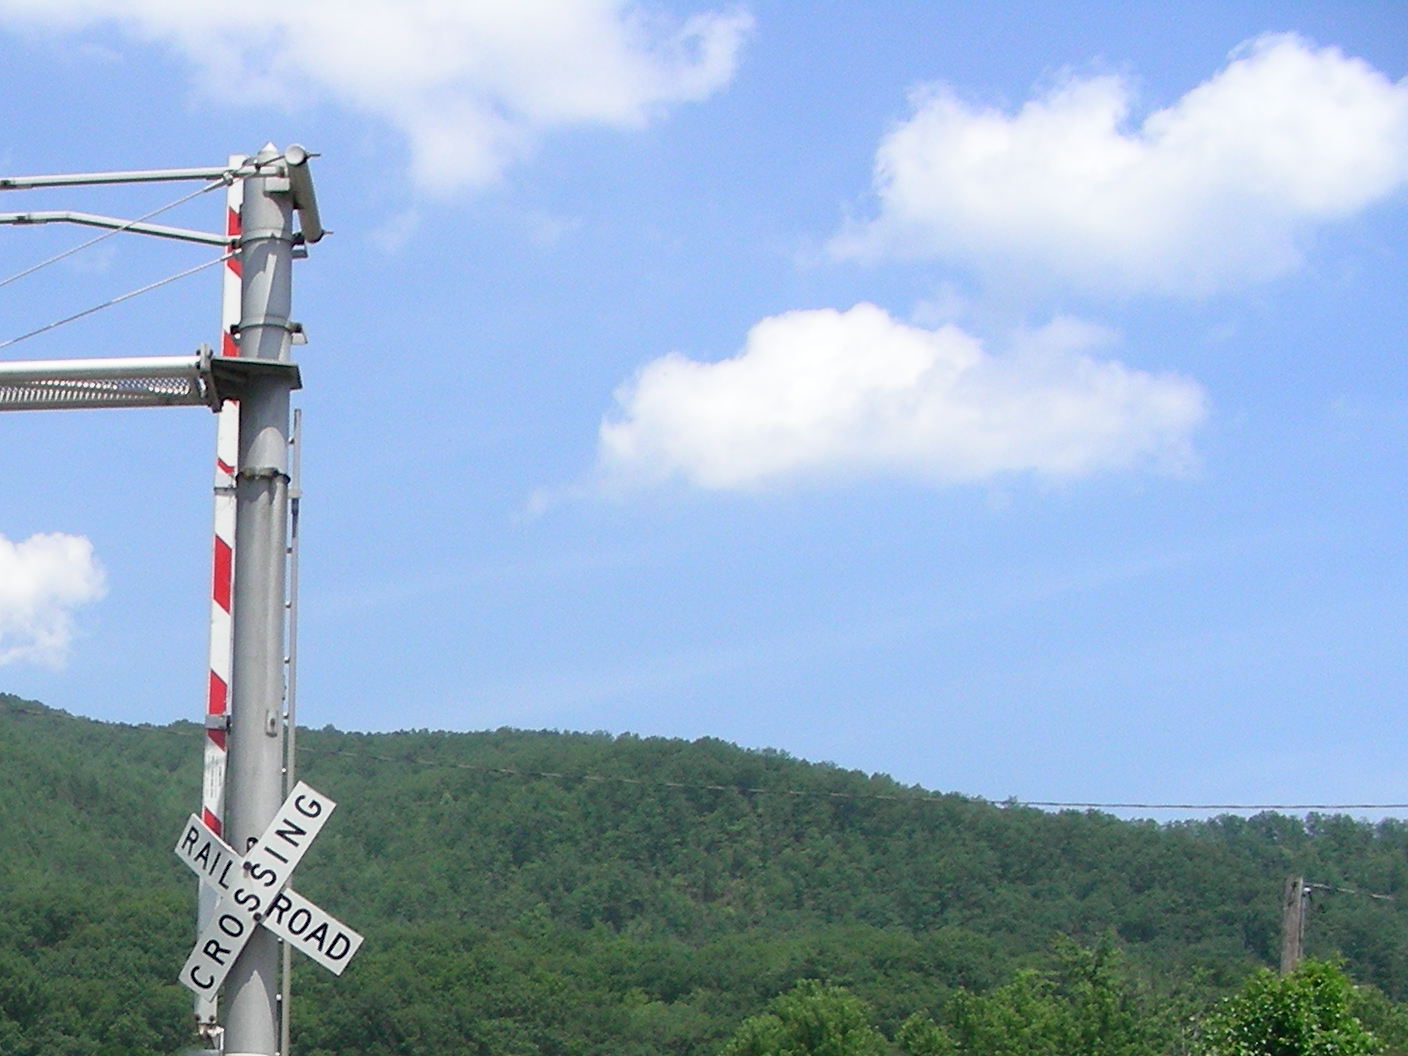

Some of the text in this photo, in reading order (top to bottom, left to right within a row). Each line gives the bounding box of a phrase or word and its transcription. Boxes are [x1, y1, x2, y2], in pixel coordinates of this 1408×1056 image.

[181, 826, 351, 961] RAIL ROAD
[190, 795, 322, 989] CROSSING
